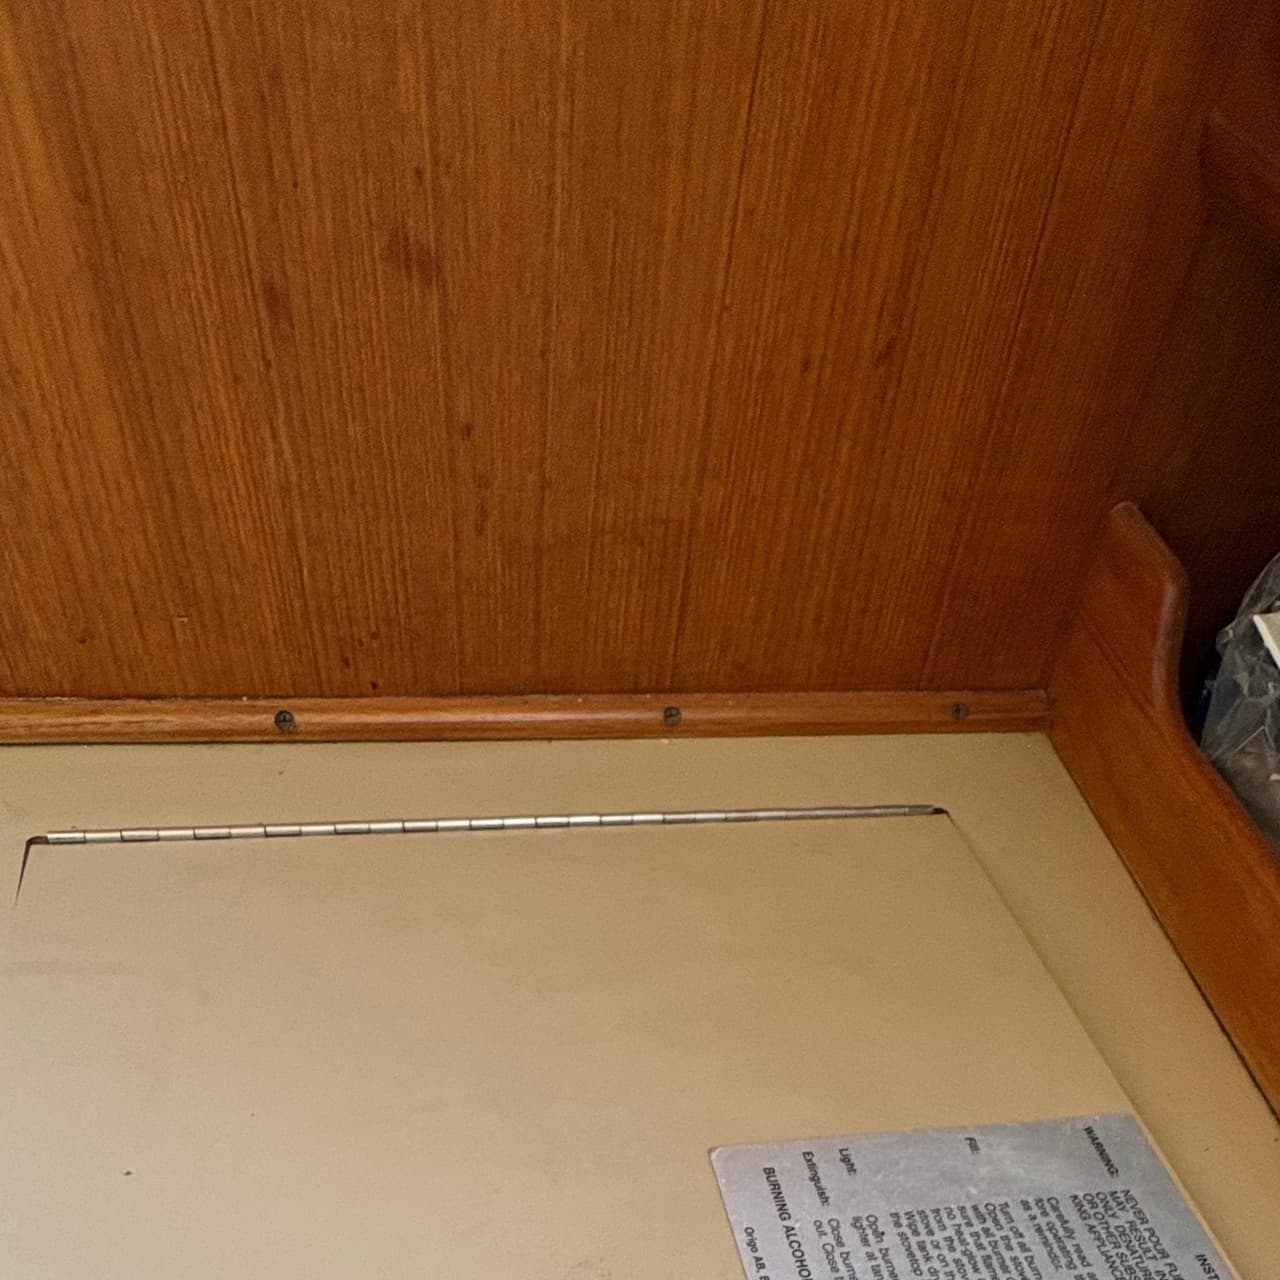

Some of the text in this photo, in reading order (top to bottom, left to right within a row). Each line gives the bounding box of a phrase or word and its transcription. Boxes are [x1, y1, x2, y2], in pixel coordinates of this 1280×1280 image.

[1069, 1194, 1091, 1221] KING
[1095, 1191, 1119, 1219] ONLY
[744, 1226, 759, 1254] Origo
[1093, 1211, 1122, 1249] OTHER
[1121, 1189, 1149, 1225] NEVER
[1144, 1227, 1170, 1260] POUR
[1125, 1220, 1158, 1261] RESULT
